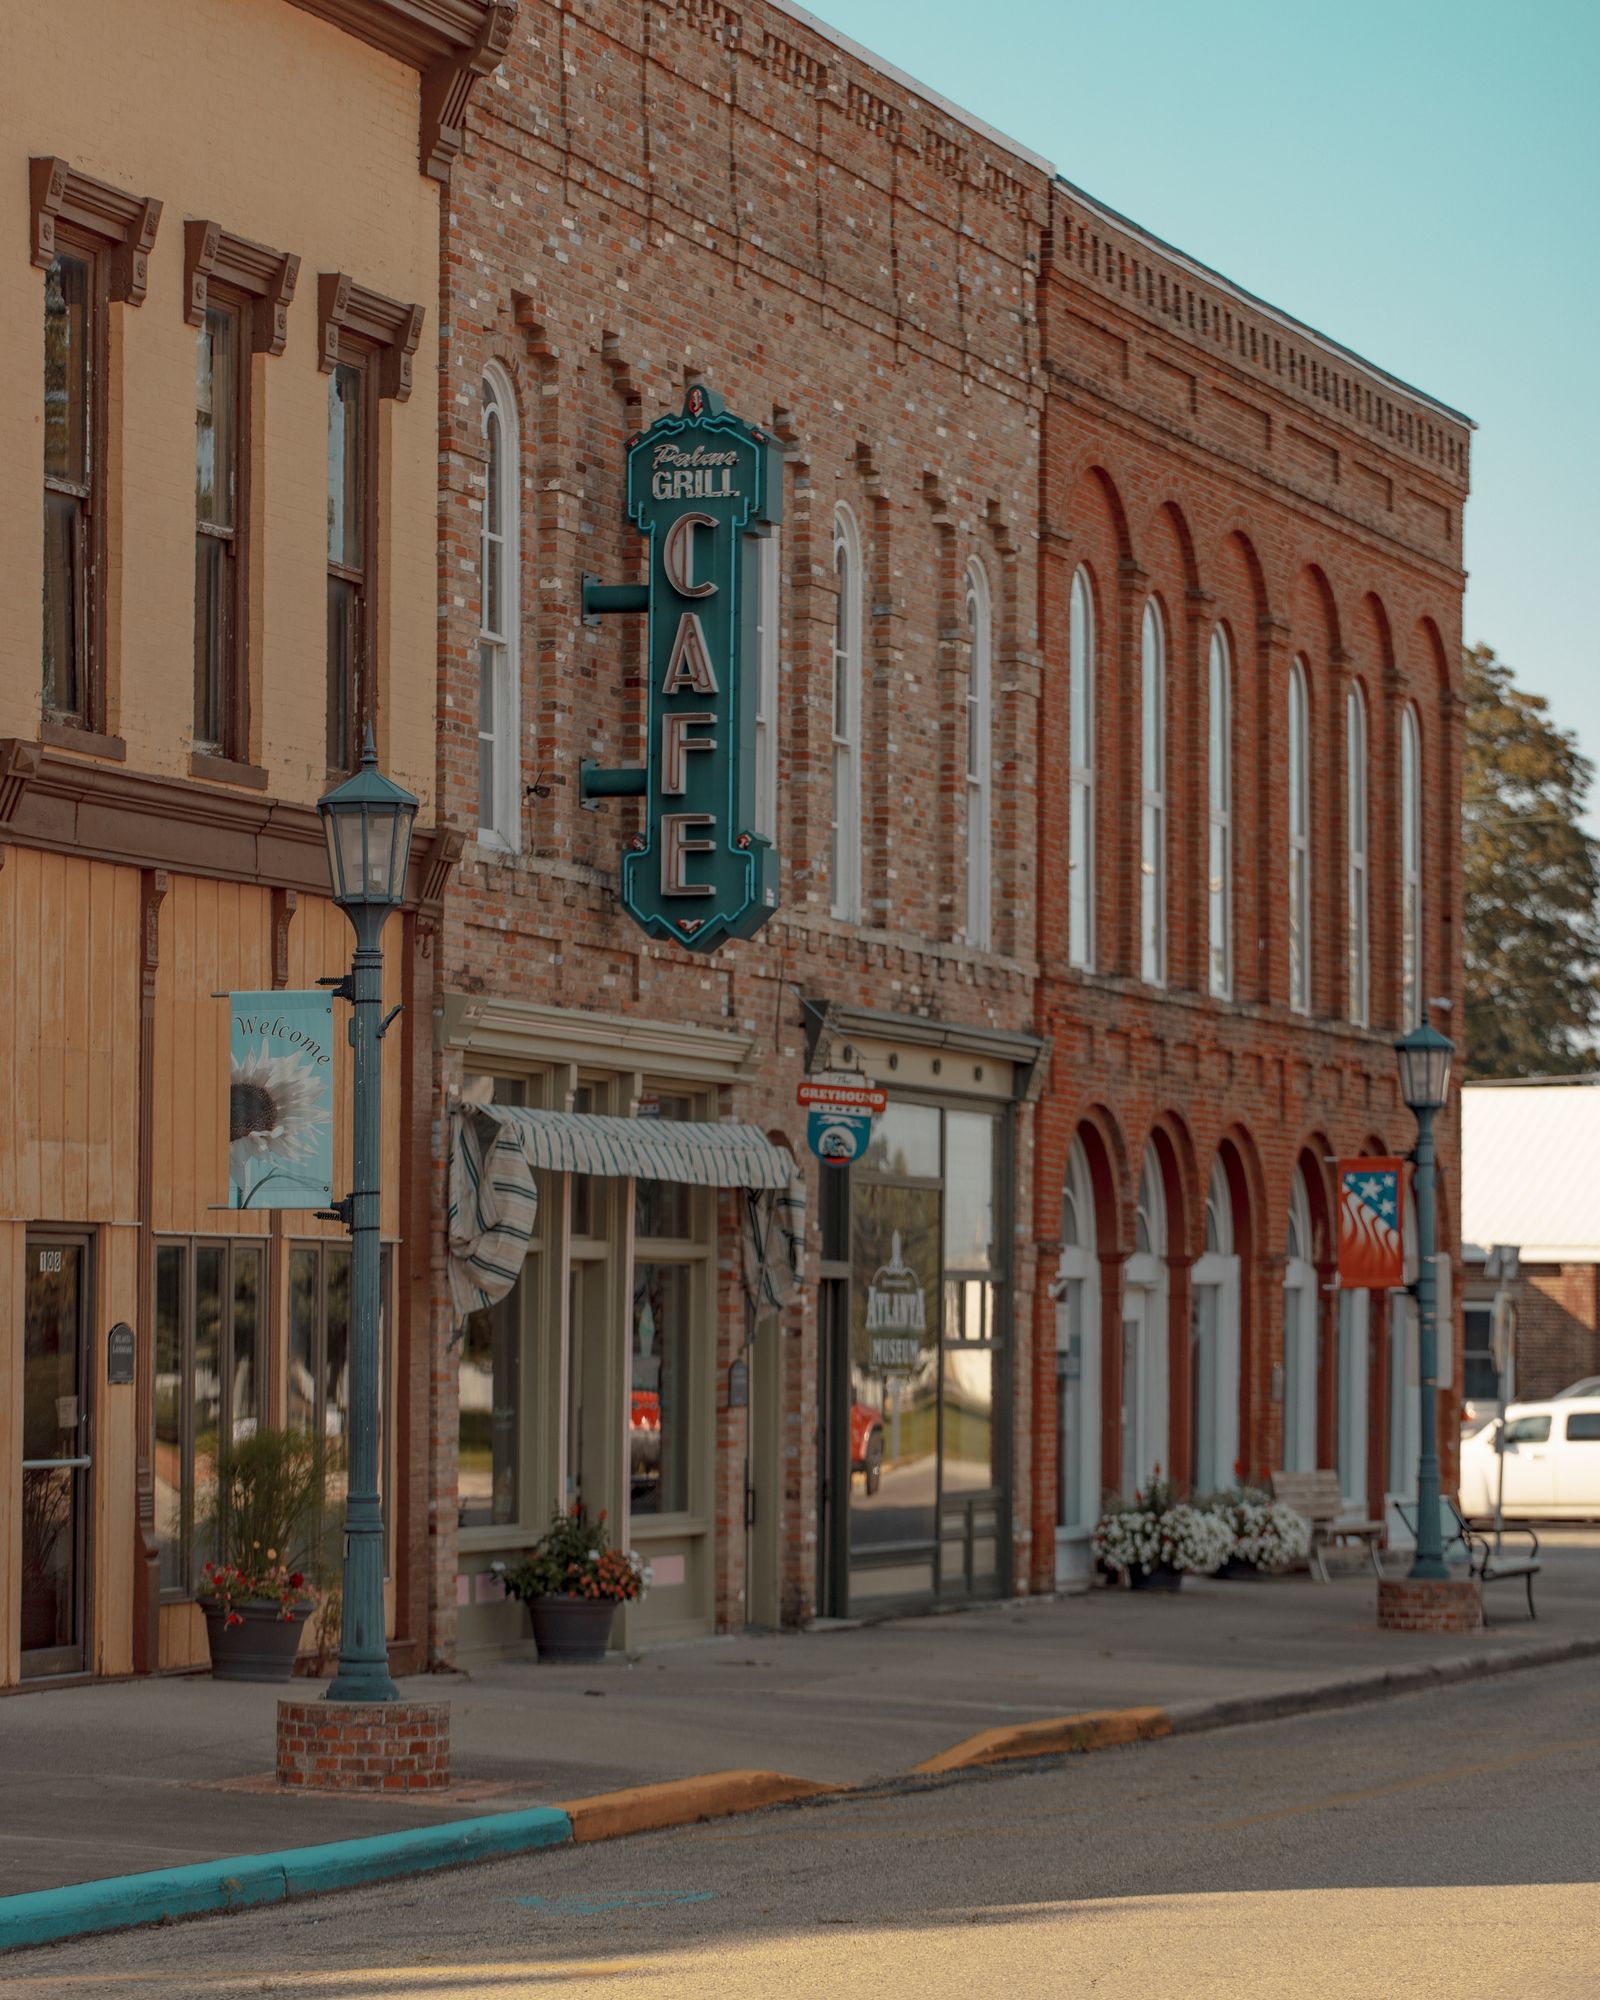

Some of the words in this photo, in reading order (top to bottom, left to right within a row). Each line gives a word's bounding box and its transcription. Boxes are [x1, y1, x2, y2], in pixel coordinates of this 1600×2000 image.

[653, 443, 739, 469] Palms
[652, 469, 740, 499] GRILL
[662, 512, 719, 896] CAFE
[235, 1017, 330, 1065] Welcome
[799, 1087, 885, 1104] GREYHOUND
[865, 1286, 926, 1329] ATLANTA
[872, 1338, 920, 1364] MUSEUM
